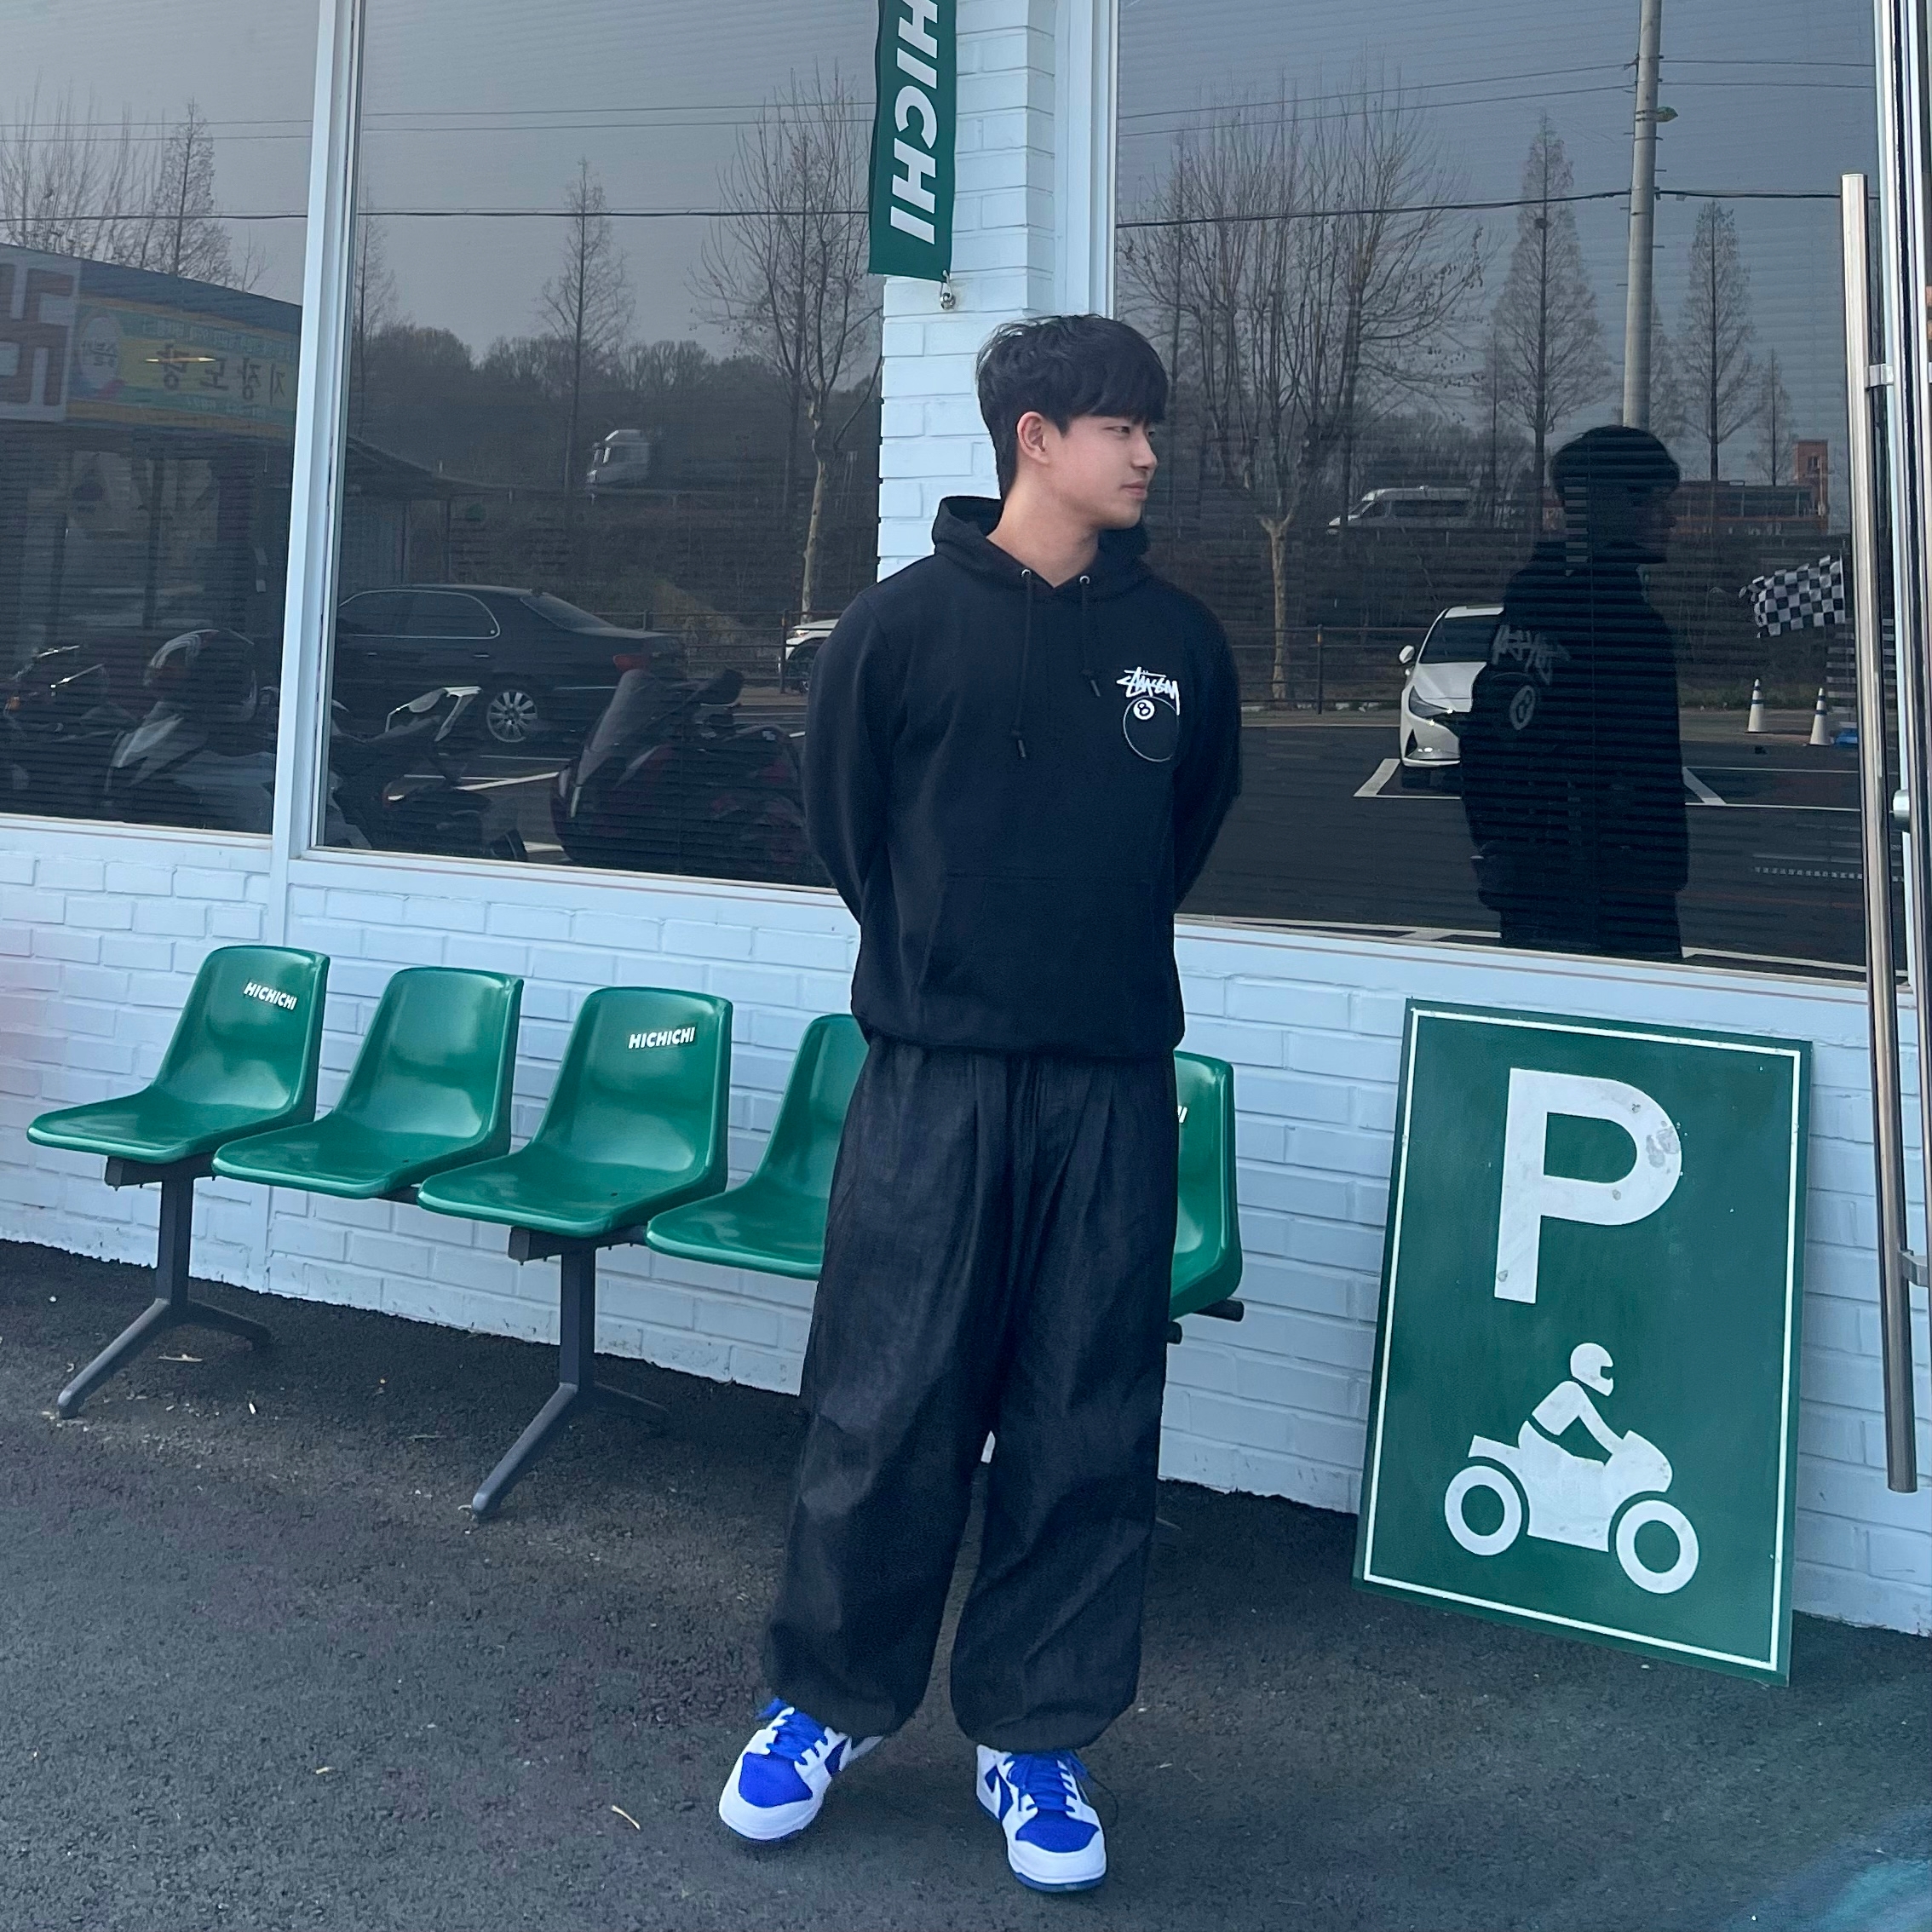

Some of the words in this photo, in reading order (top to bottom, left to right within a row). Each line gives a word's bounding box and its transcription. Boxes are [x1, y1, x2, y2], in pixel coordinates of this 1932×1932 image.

[1137, 702, 1152, 716] 8
[243, 981, 297, 1010] HICHICHI
[628, 1026, 696, 1049] HICHICHI
[1494, 1067, 1682, 1305] P
